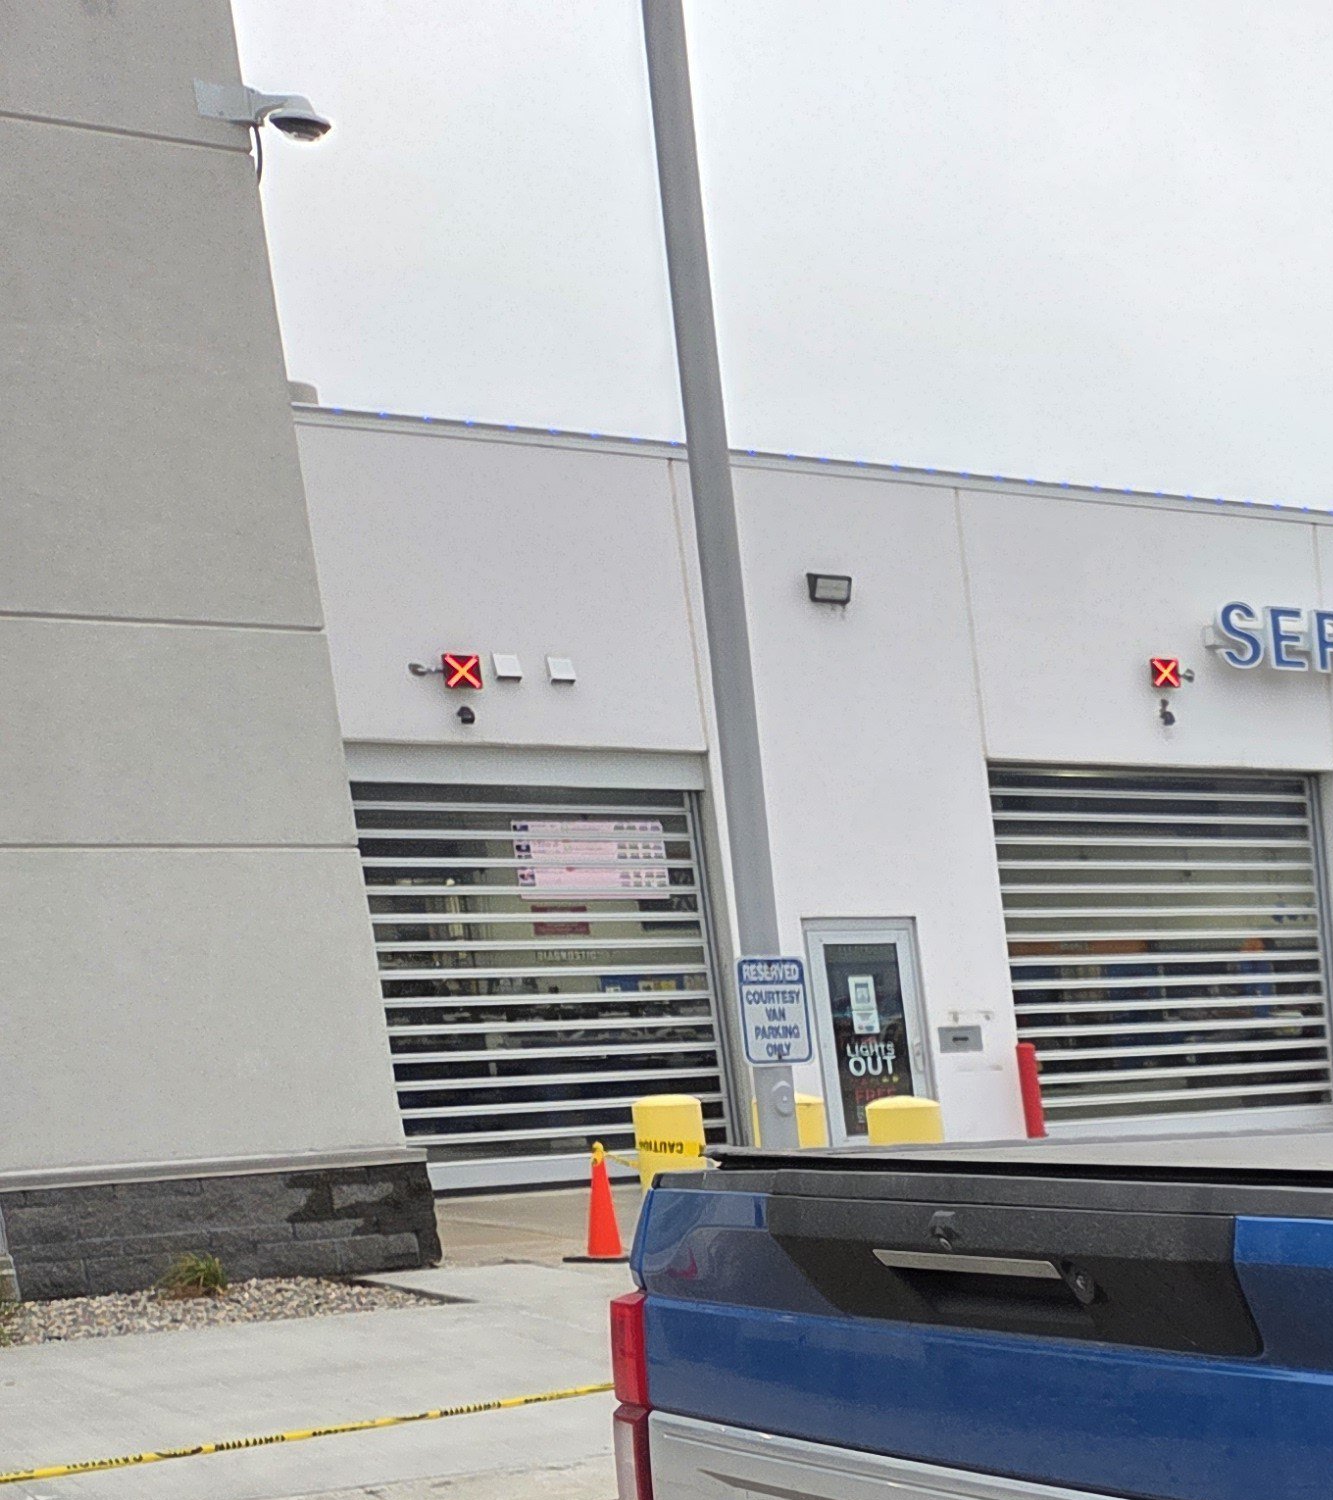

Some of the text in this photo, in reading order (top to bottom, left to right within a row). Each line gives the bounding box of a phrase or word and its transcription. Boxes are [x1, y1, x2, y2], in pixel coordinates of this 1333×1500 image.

[742, 963, 800, 982] RESERVED
[745, 989, 801, 1006] COURTESY
[765, 1006, 786, 1022] VAN
[754, 1024, 800, 1041] PARKING
[765, 1042, 792, 1057] ONLY
[848, 1056, 896, 1077] OUT
